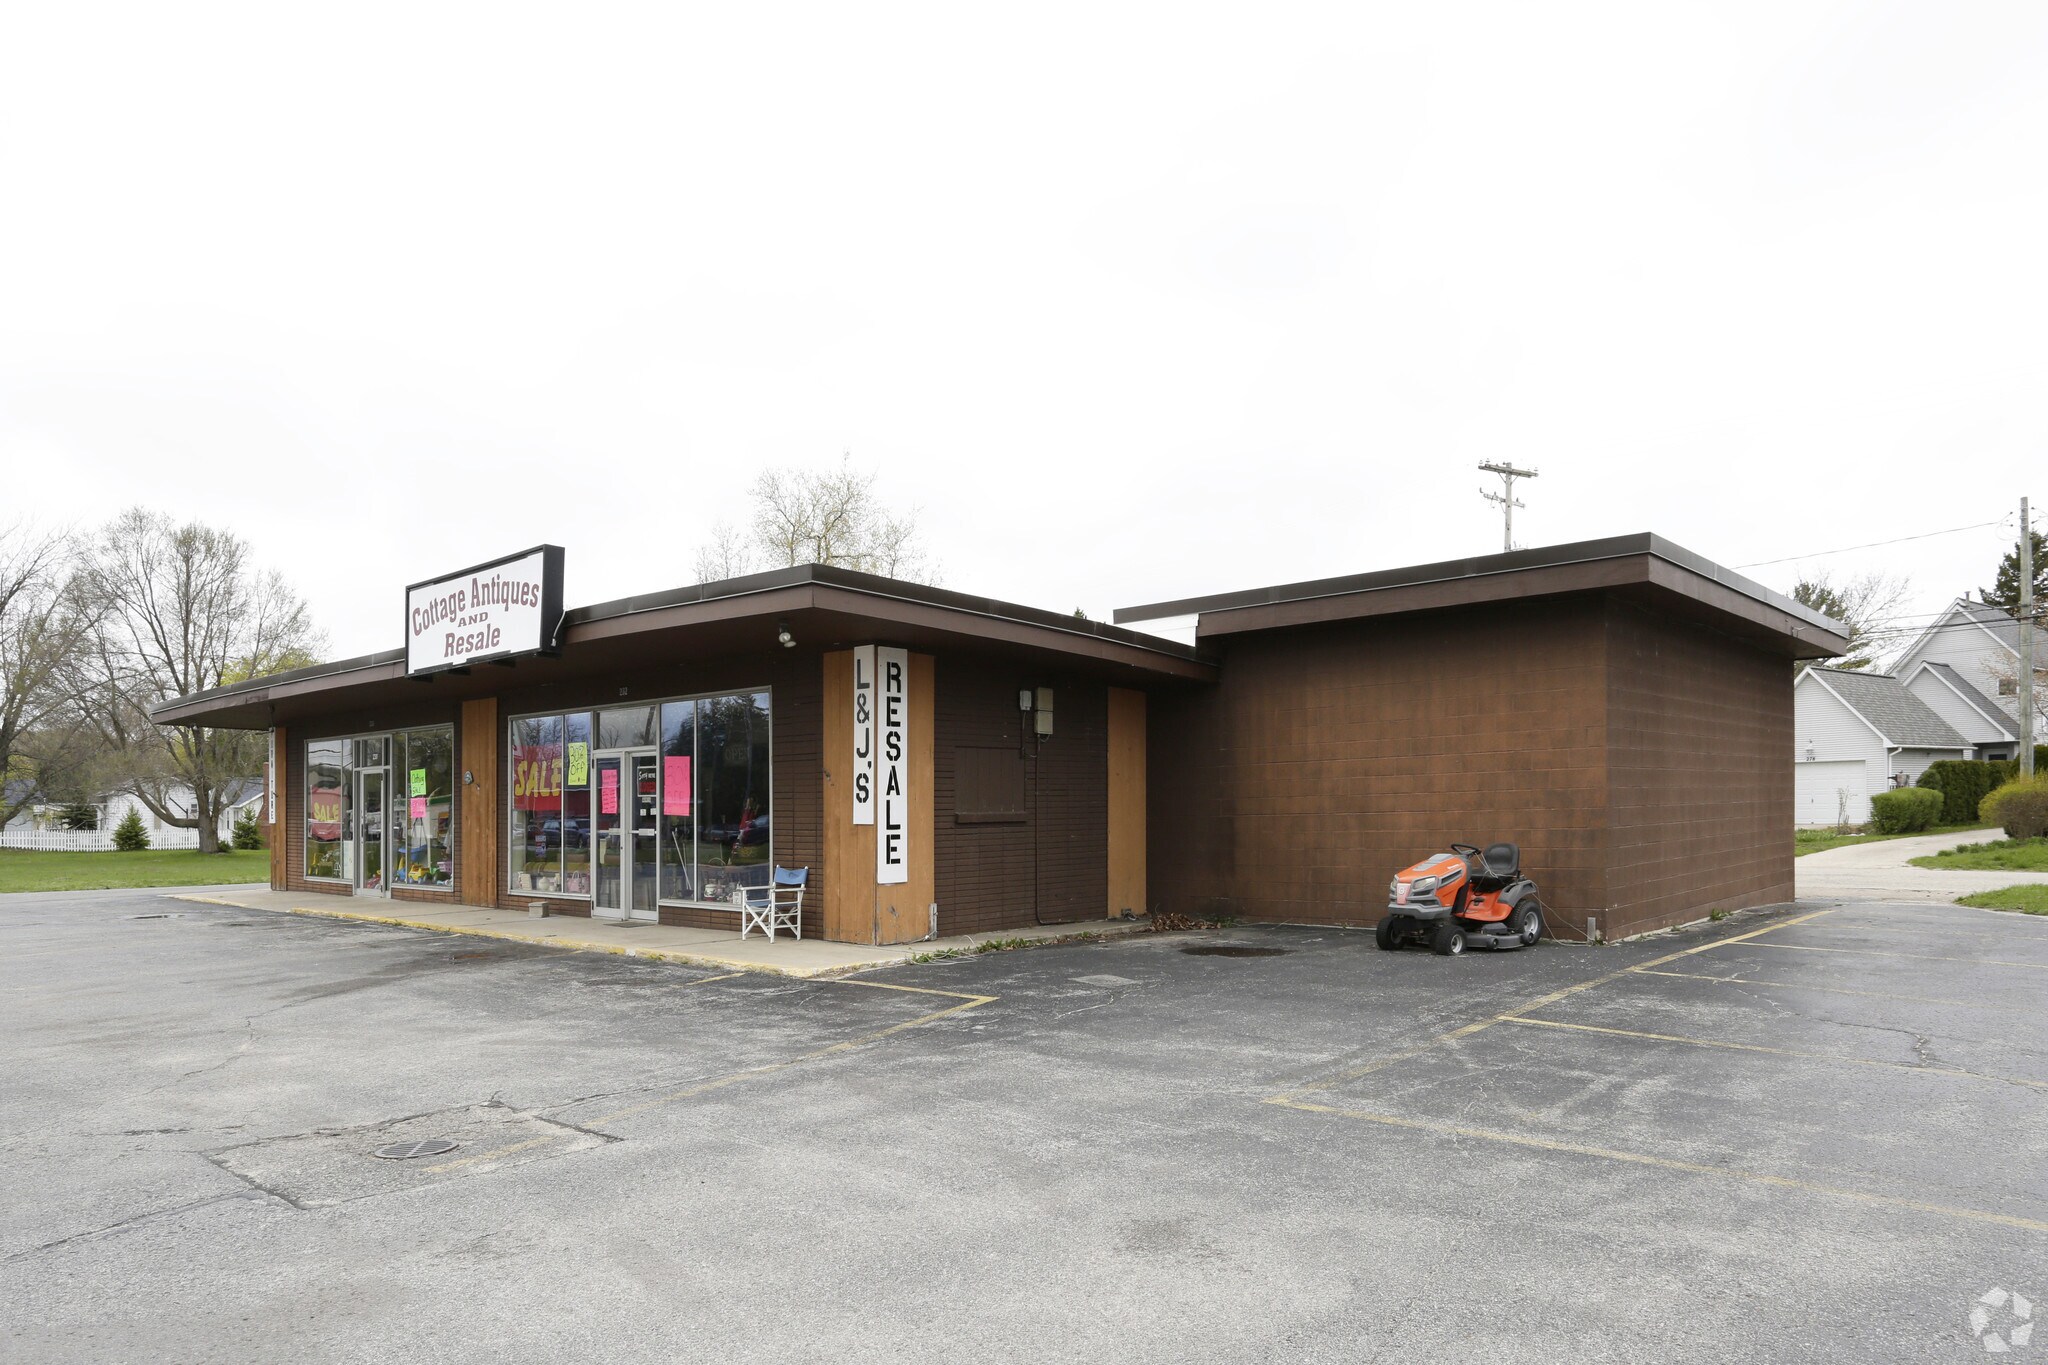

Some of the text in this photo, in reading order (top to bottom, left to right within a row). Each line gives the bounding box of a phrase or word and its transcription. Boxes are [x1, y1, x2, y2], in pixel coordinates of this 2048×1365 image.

[412, 573, 540, 637] Cottage Antiques
[457, 611, 489, 628] AND
[443, 623, 501, 658] Resale
[514, 758, 562, 798] SALE
[885, 661, 901, 865] RESALE
[313, 801, 340, 822] SALE
